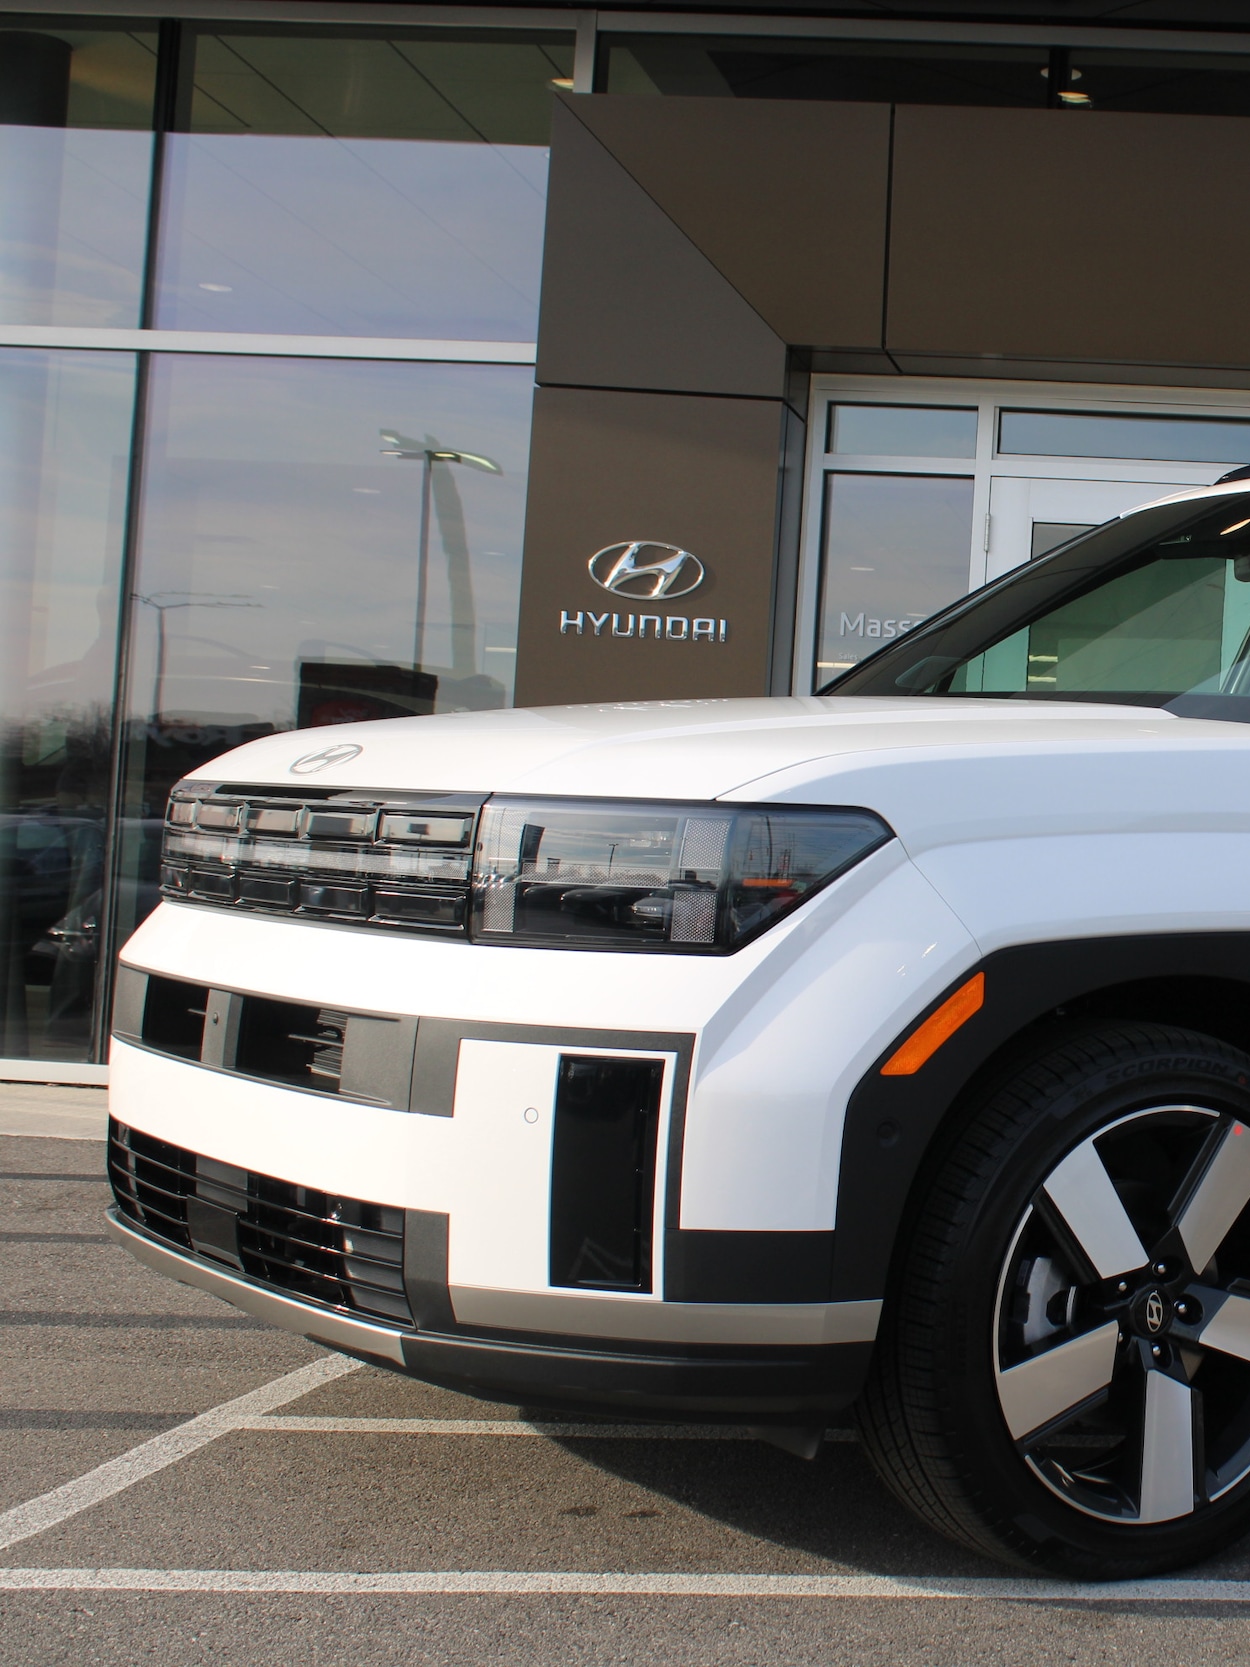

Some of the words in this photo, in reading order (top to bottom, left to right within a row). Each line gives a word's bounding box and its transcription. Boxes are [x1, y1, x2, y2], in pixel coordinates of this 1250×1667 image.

[559, 610, 728, 643] HYUNDAI
[839, 611, 924, 639] Mass
[1104, 1056, 1229, 1085] SCORPION
